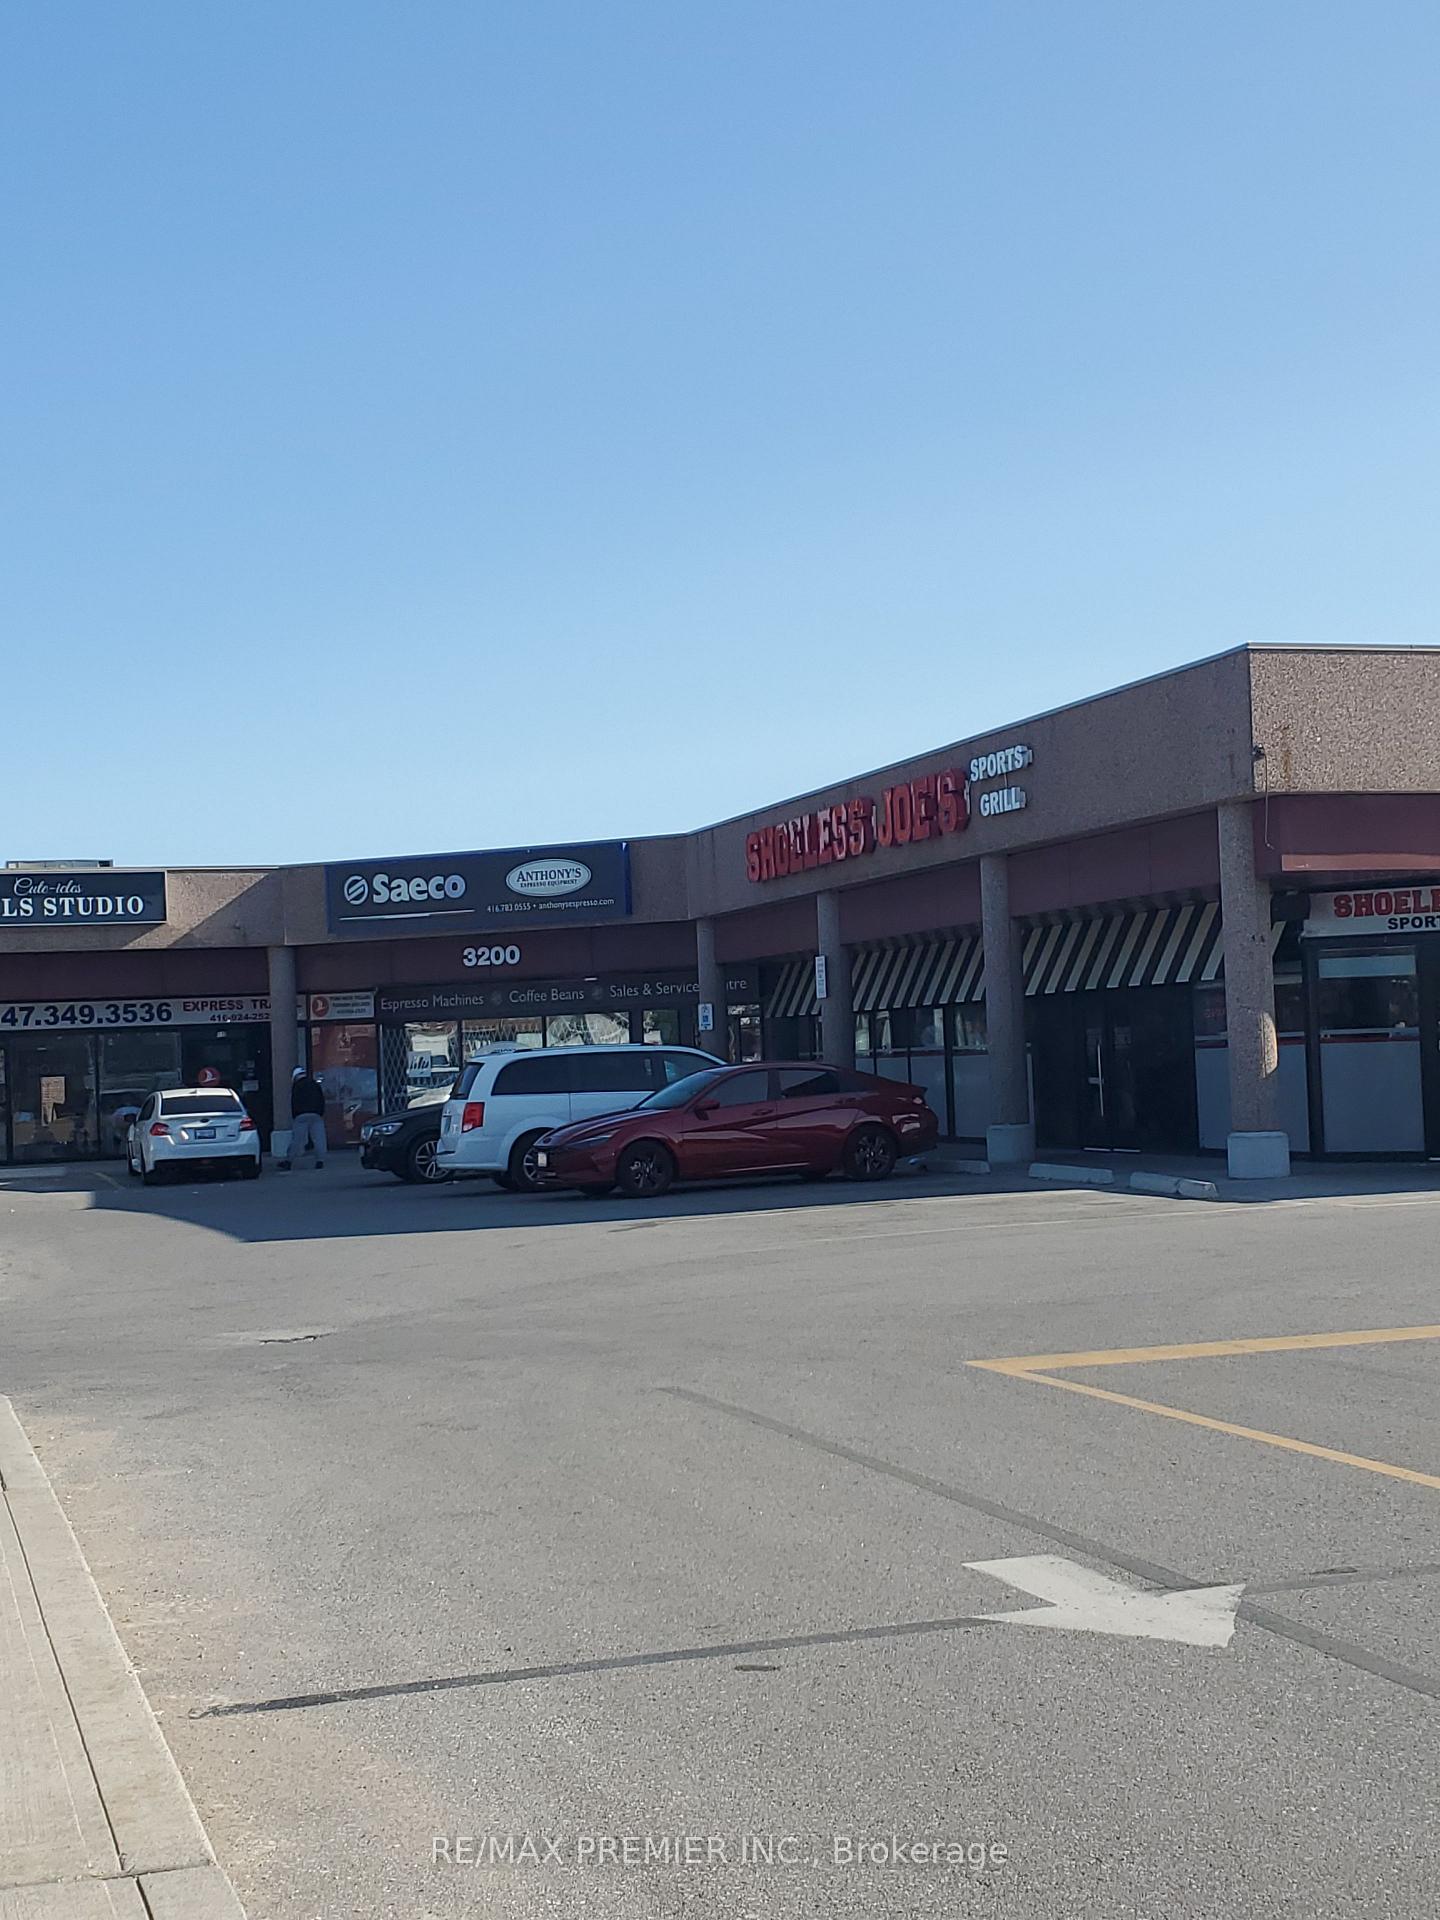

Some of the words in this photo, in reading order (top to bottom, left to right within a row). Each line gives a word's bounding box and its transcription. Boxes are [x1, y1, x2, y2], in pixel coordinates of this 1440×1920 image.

[970, 745, 1028, 782] SPORTS
[980, 787, 1023, 817] GRILL
[745, 798, 873, 881] SHOELESS
[878, 768, 967, 848] JOE'S
[516, 867, 582, 884] ANTHONY'S
[548, 878, 577, 887] EQUIPMENT
[372, 873, 467, 904] Saeco
[43, 896, 144, 917] STUDIO
[1387, 915, 1440, 930] SPOR
[463, 945, 521, 967] 3200
[183, 999, 244, 1012] EXPRESS
[381, 998, 429, 1013] Espresso
[432, 994, 484, 1008] Machines
[509, 990, 547, 1003] Coffee
[551, 988, 584, 1000] Beans
[609, 984, 639, 998] Sales
[642, 983, 652, 996] &
[655, 982, 700, 995] Service
[1, 1002, 173, 1027] 47.349.3536
